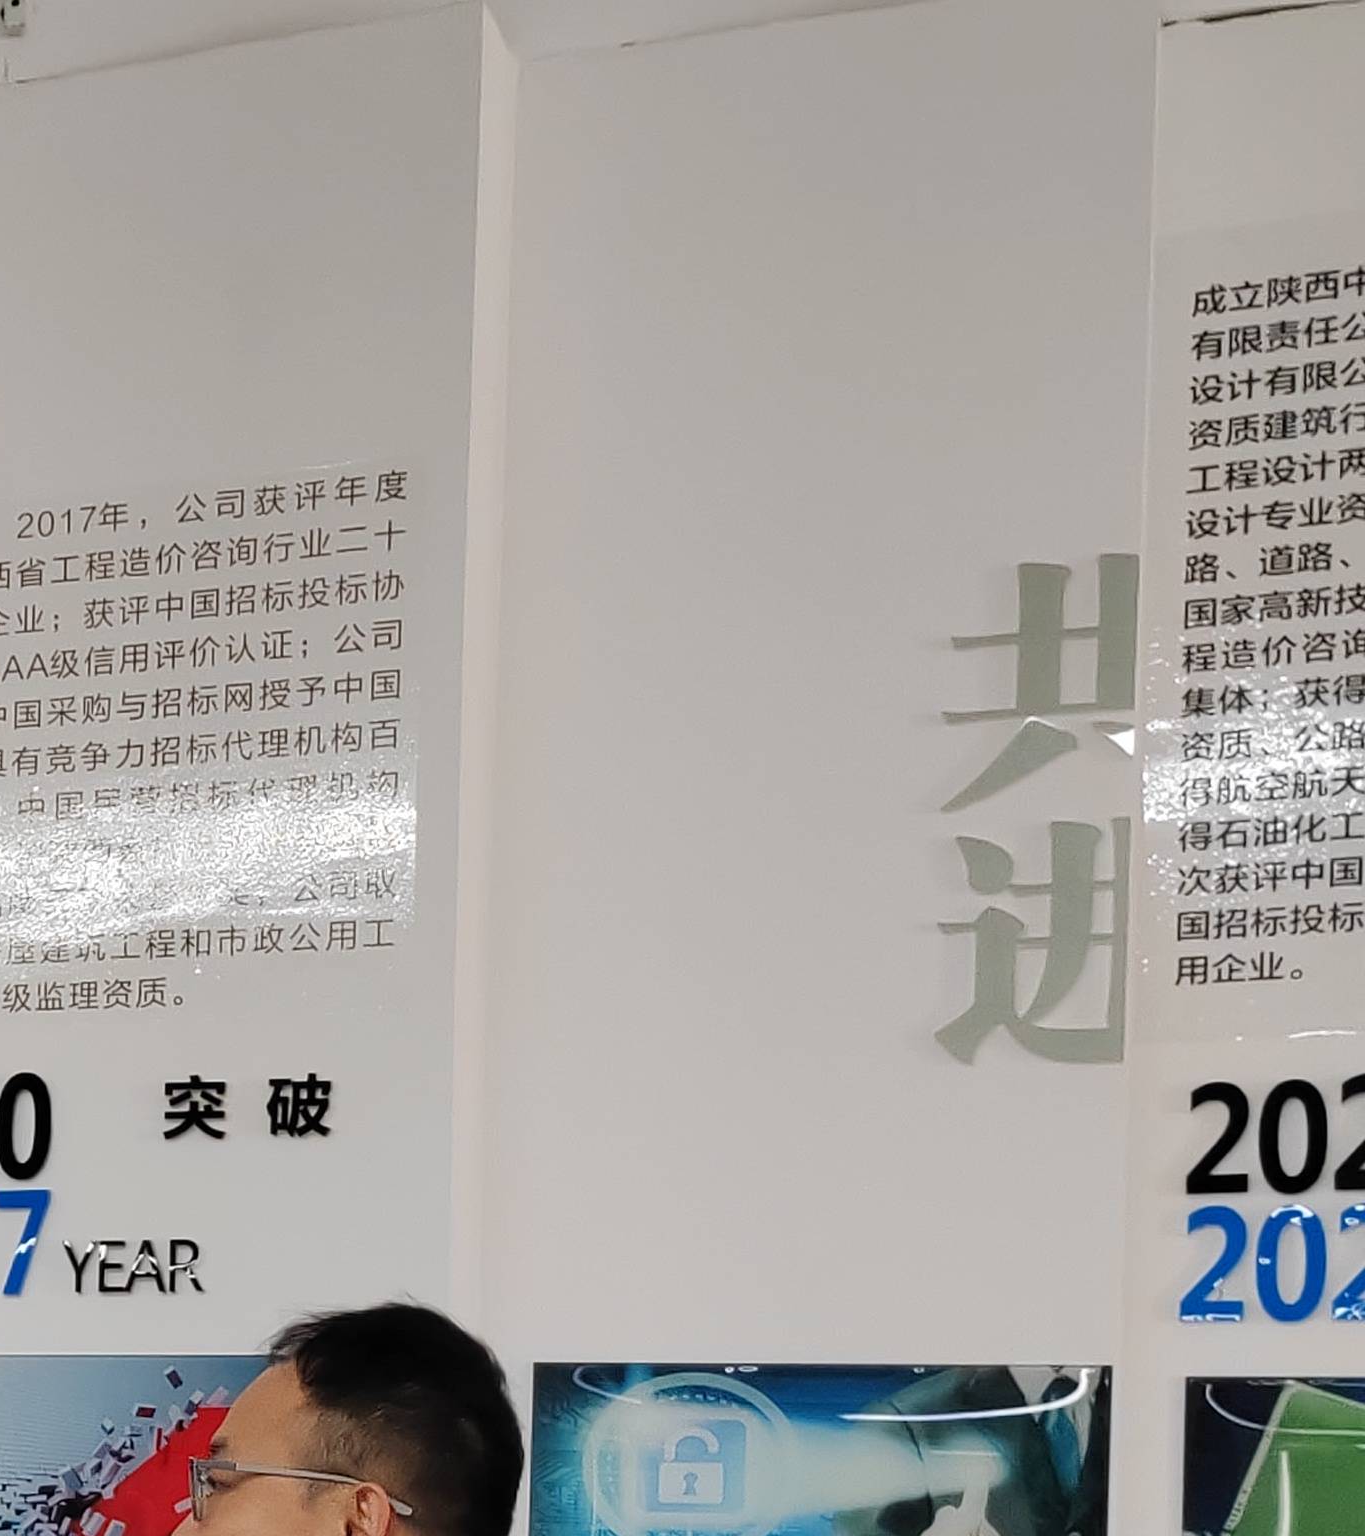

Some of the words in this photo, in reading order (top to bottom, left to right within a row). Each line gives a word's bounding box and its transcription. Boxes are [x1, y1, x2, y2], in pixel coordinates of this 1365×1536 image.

[16, 469, 408, 541] 2017年，公司获评年度
[1177, 856, 1364, 896] 次获评中国
[1174, 951, 1303, 986] 用企业。
[62, 1238, 206, 1294] YEAR
